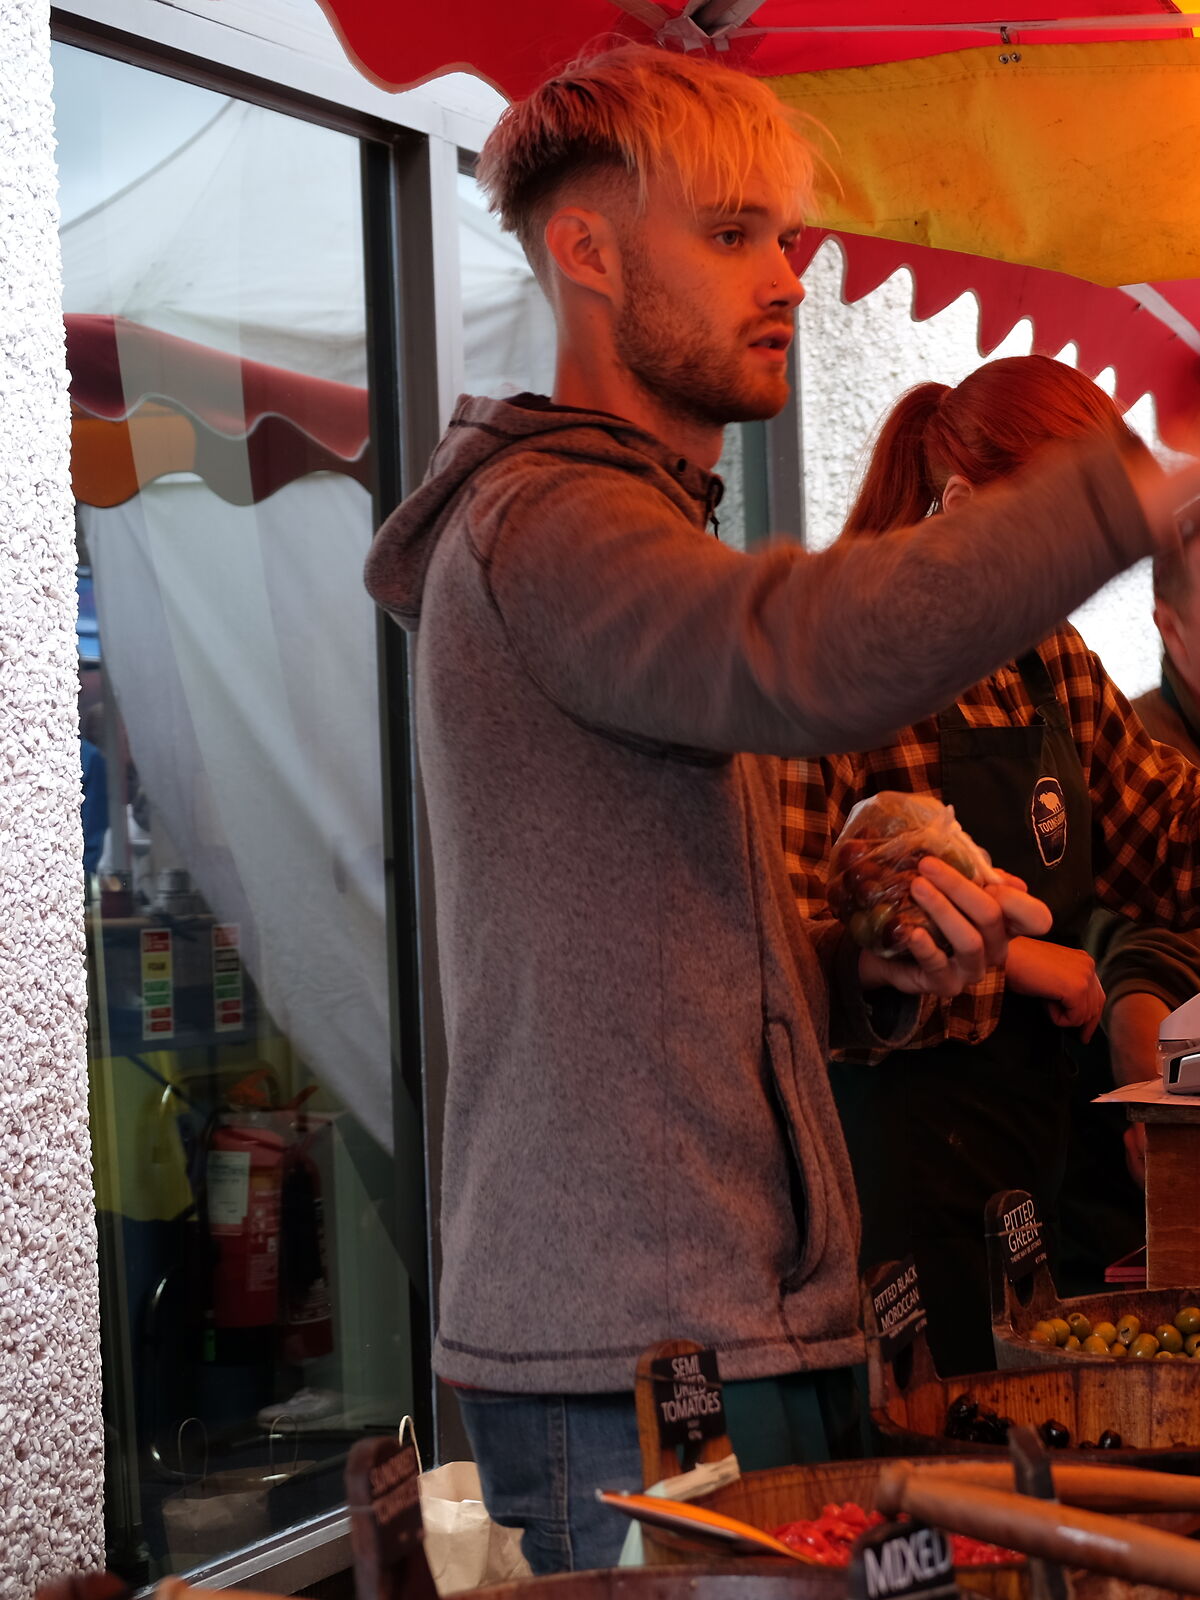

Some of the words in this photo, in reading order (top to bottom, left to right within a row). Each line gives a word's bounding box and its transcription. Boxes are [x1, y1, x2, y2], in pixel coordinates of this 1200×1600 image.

[1003, 1199, 1035, 1232] PITTED
[1008, 1218, 1039, 1253] GREEN
[874, 1283, 897, 1313] PITTED
[897, 1264, 918, 1293] BLACK
[881, 1286, 920, 1331] MOROCCAN
[672, 1355, 700, 1377] SEMI
[661, 1391, 721, 1422] TOMATOES
[863, 1528, 952, 1599] MIXED
